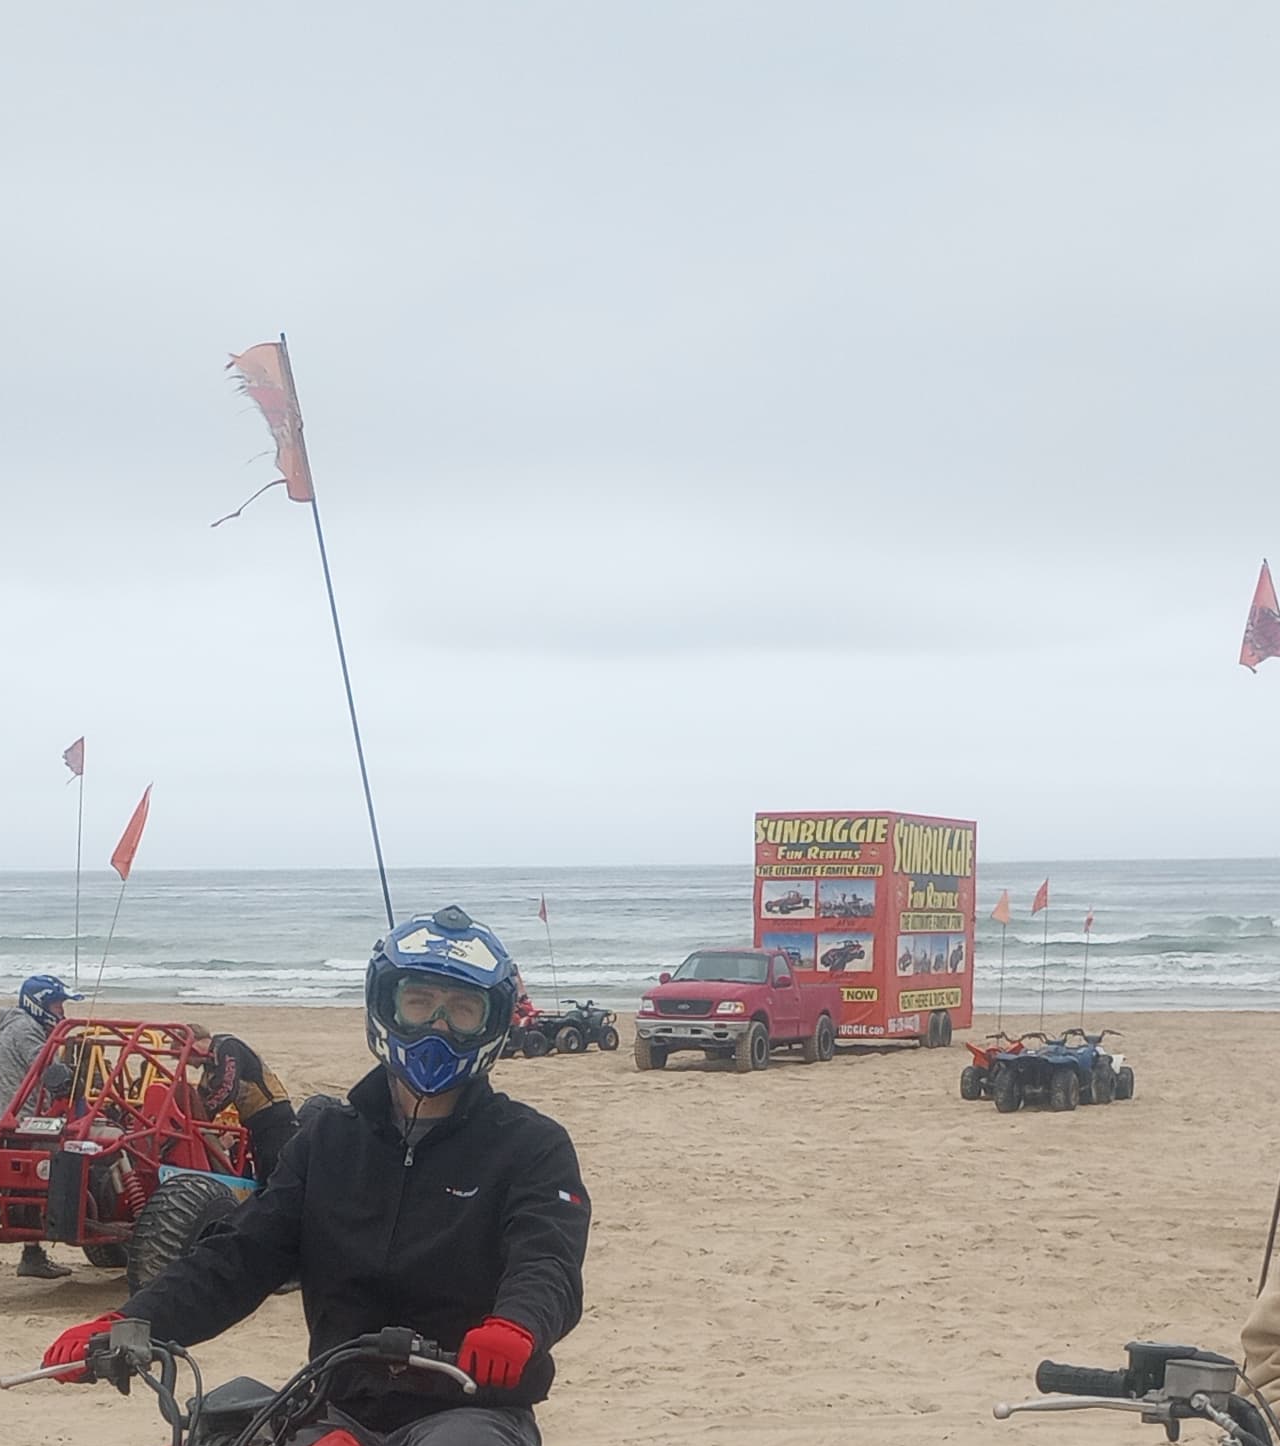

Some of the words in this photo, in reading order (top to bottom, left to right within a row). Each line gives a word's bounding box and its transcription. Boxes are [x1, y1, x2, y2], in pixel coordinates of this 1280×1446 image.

[755, 817, 889, 844] SUNBUGGIE
[893, 818, 973, 877] SUNBUGGIE
[758, 865, 773, 875] THE
[775, 865, 818, 875] ULTIMATE
[820, 865, 854, 875] FAMILY
[846, 990, 875, 1001] NOW
